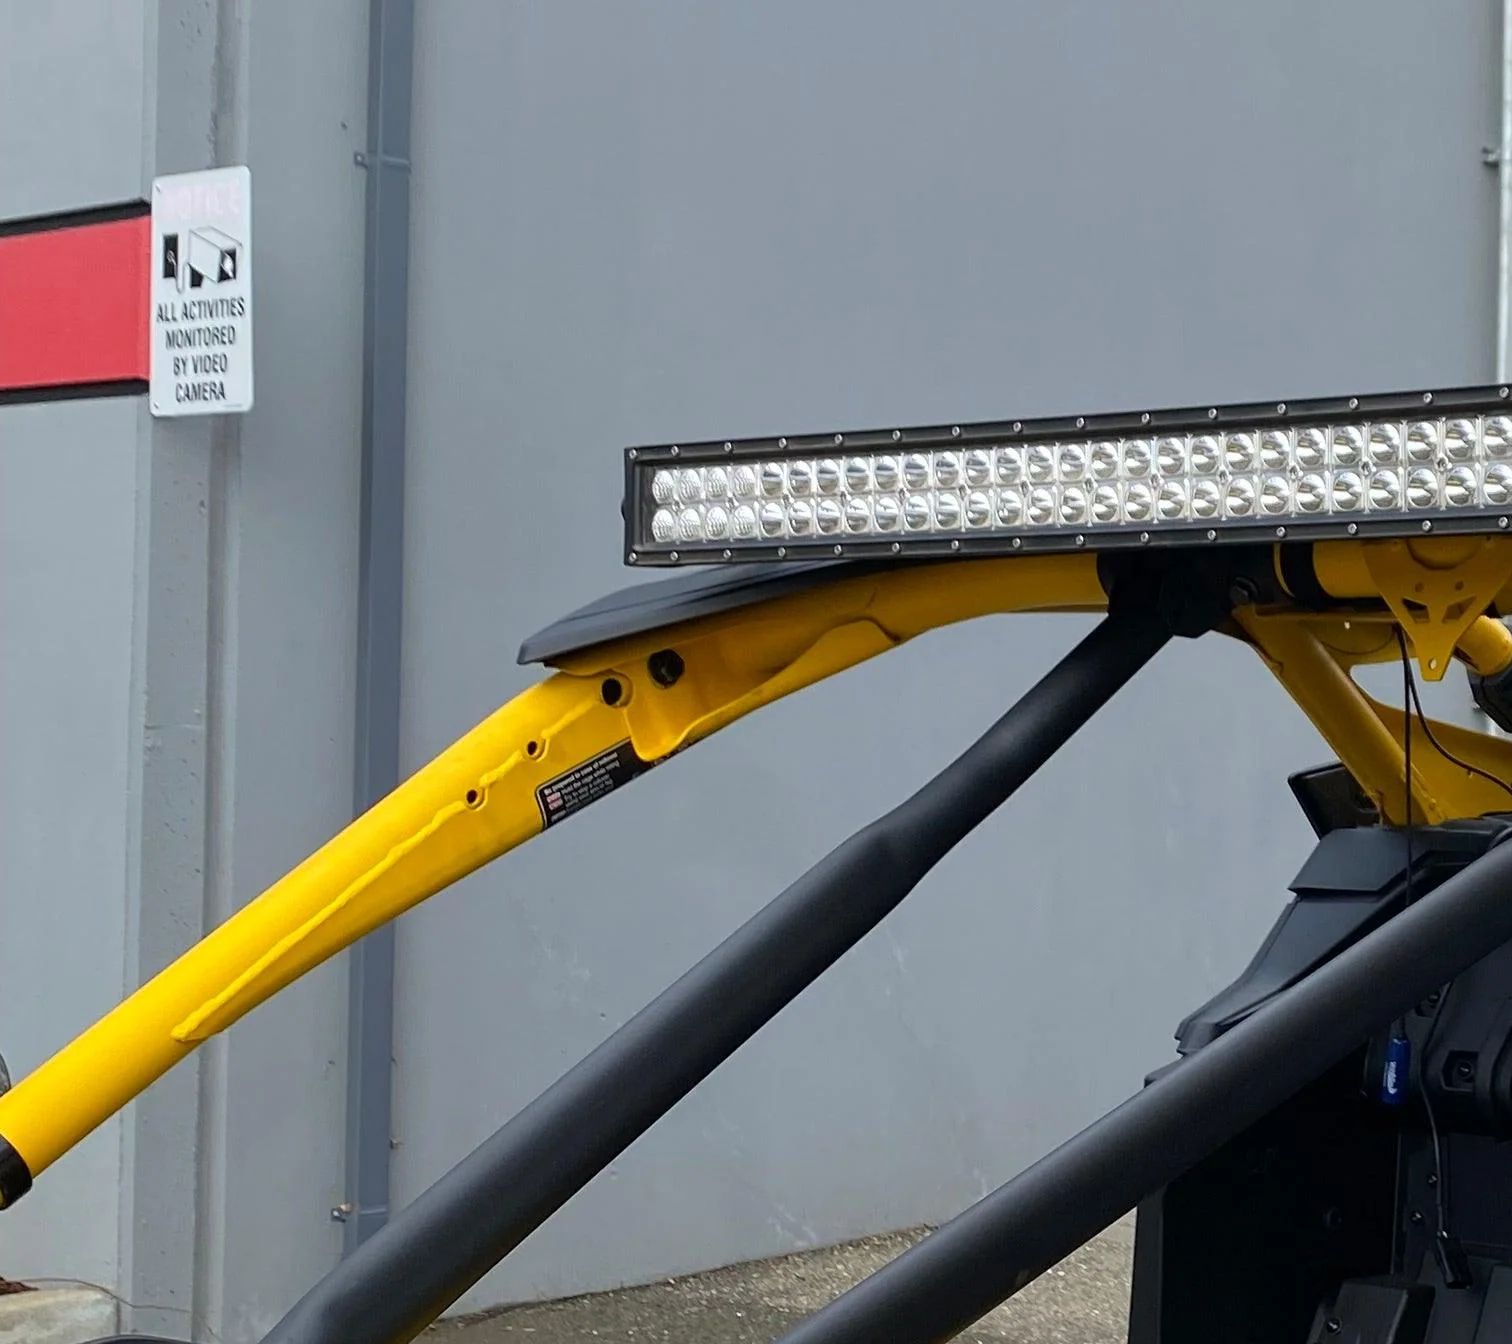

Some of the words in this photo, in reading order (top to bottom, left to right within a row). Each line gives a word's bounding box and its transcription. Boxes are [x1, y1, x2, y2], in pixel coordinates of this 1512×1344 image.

[157, 302, 178, 322] ALL
[181, 296, 246, 322] ACTIVITIES
[165, 324, 236, 350] MONITORED
[173, 355, 188, 376] BY
[191, 352, 228, 374] VIDEO
[175, 380, 226, 403] CAMERA
